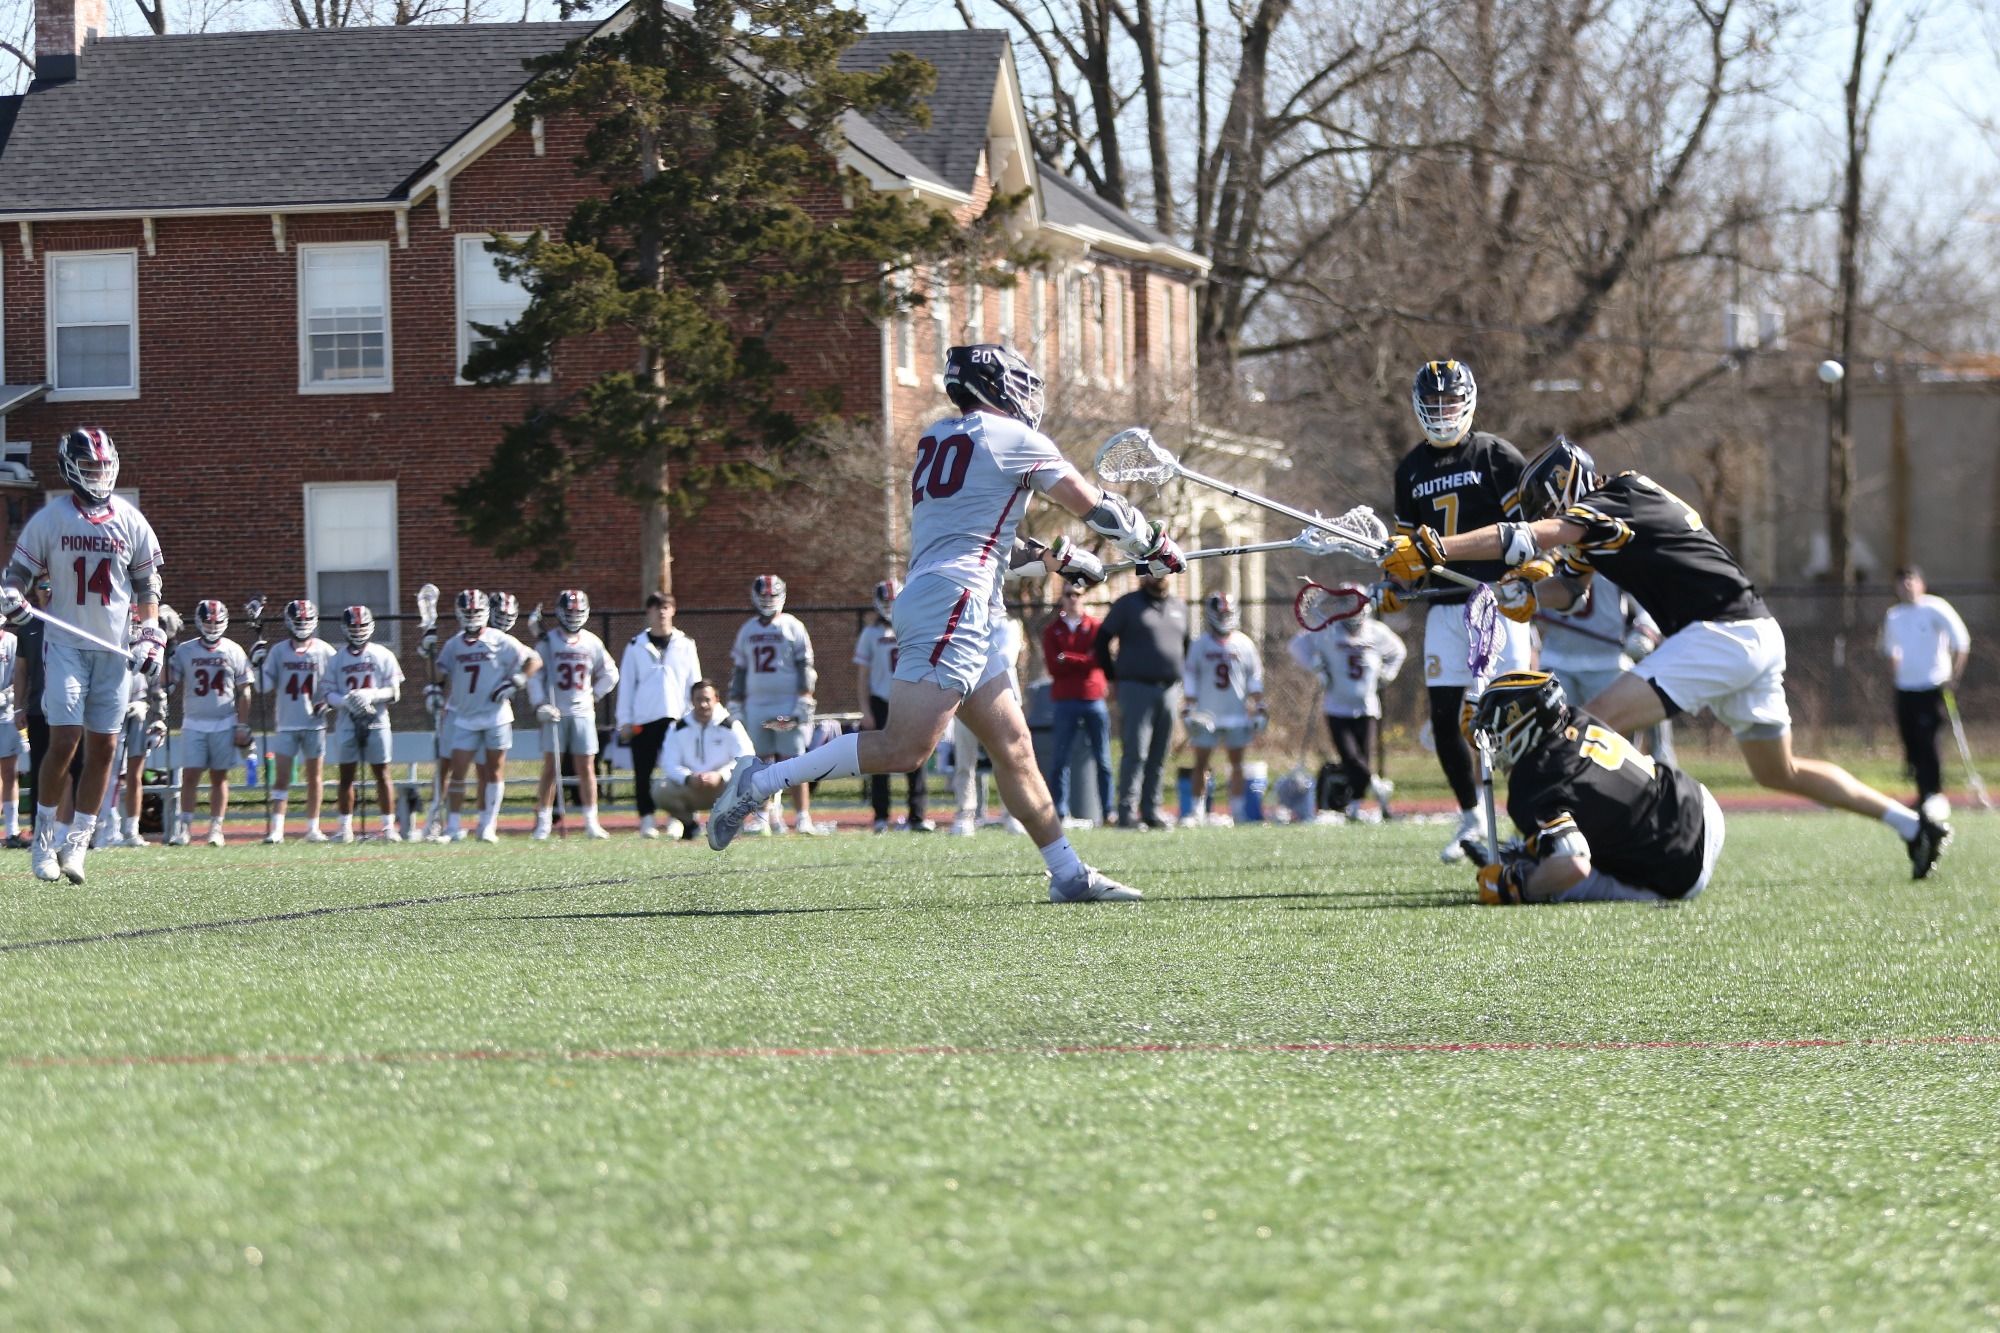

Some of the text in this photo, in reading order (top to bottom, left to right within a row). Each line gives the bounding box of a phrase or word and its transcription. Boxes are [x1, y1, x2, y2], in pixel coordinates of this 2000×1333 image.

[970, 349, 992, 364] 20
[911, 433, 975, 510] 20
[1432, 492, 1460, 538] 7
[61, 535, 126, 555] PIONEERS
[73, 556, 113, 607] 14
[753, 646, 777, 674] 12
[1348, 655, 1364, 681] 5
[194, 669, 225, 698] 34
[285, 673, 314, 701] 44
[464, 664, 480, 694] 7
[1215, 662, 1230, 690] 9
